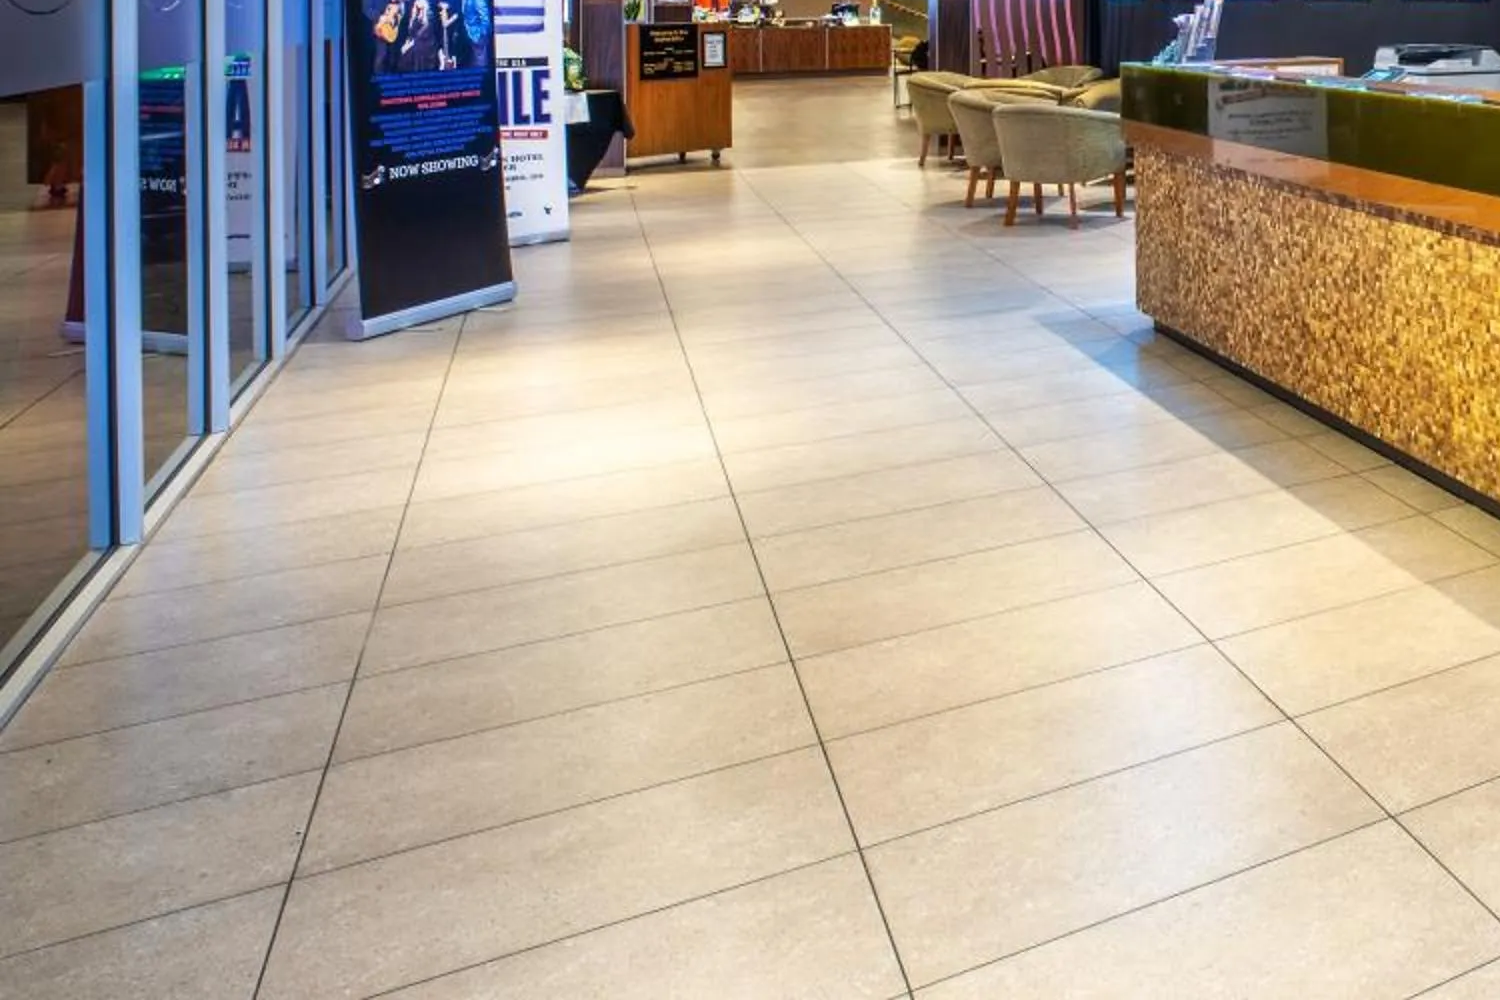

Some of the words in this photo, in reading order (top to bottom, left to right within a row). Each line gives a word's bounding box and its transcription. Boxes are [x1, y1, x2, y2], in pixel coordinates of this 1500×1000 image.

[497, 69, 552, 125] ILE
[389, 163, 420, 180] NOW
[421, 155, 479, 175] SHOWING
